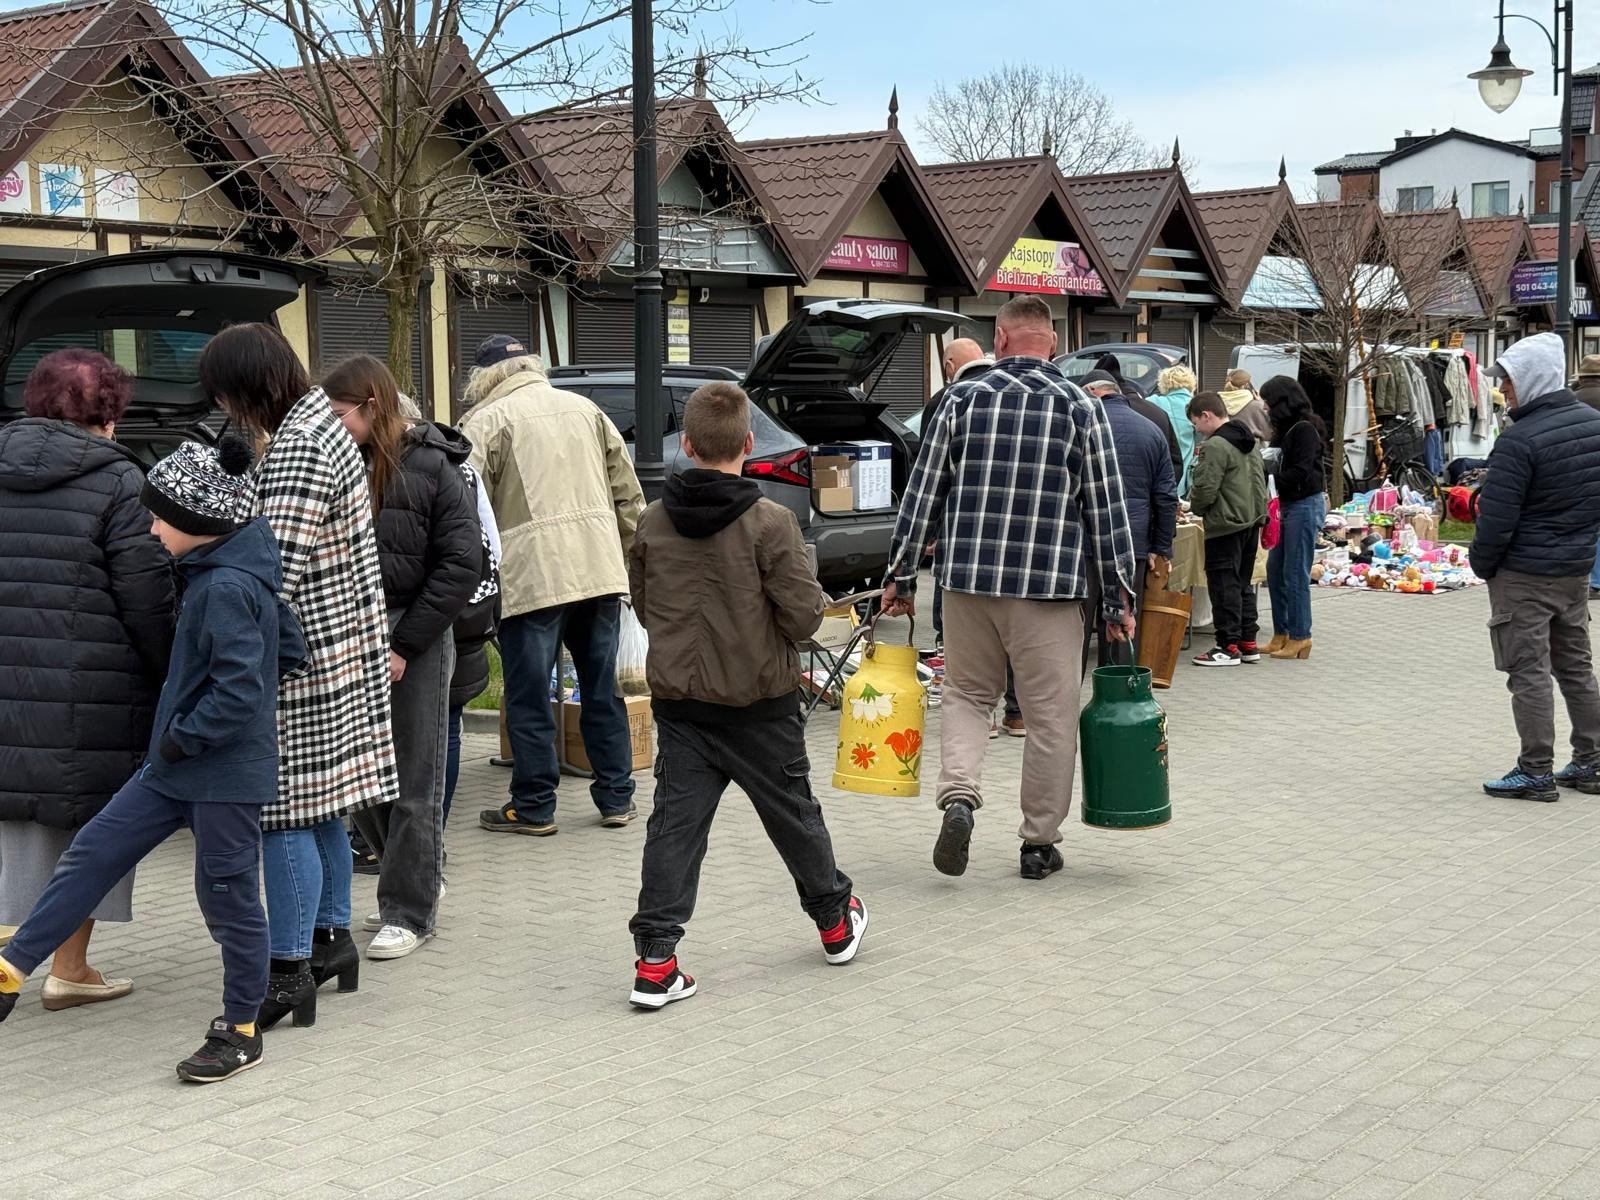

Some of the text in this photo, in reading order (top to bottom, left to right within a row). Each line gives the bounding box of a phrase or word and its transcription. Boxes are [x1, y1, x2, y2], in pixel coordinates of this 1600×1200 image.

[0, 179, 24, 196] ONY
[831, 240, 898, 262] eauty salon
[1010, 246, 1055, 268] Rajstopy
[1042, 272, 1102, 290] Pasmanteria
[1515, 283, 1530, 292] 501
